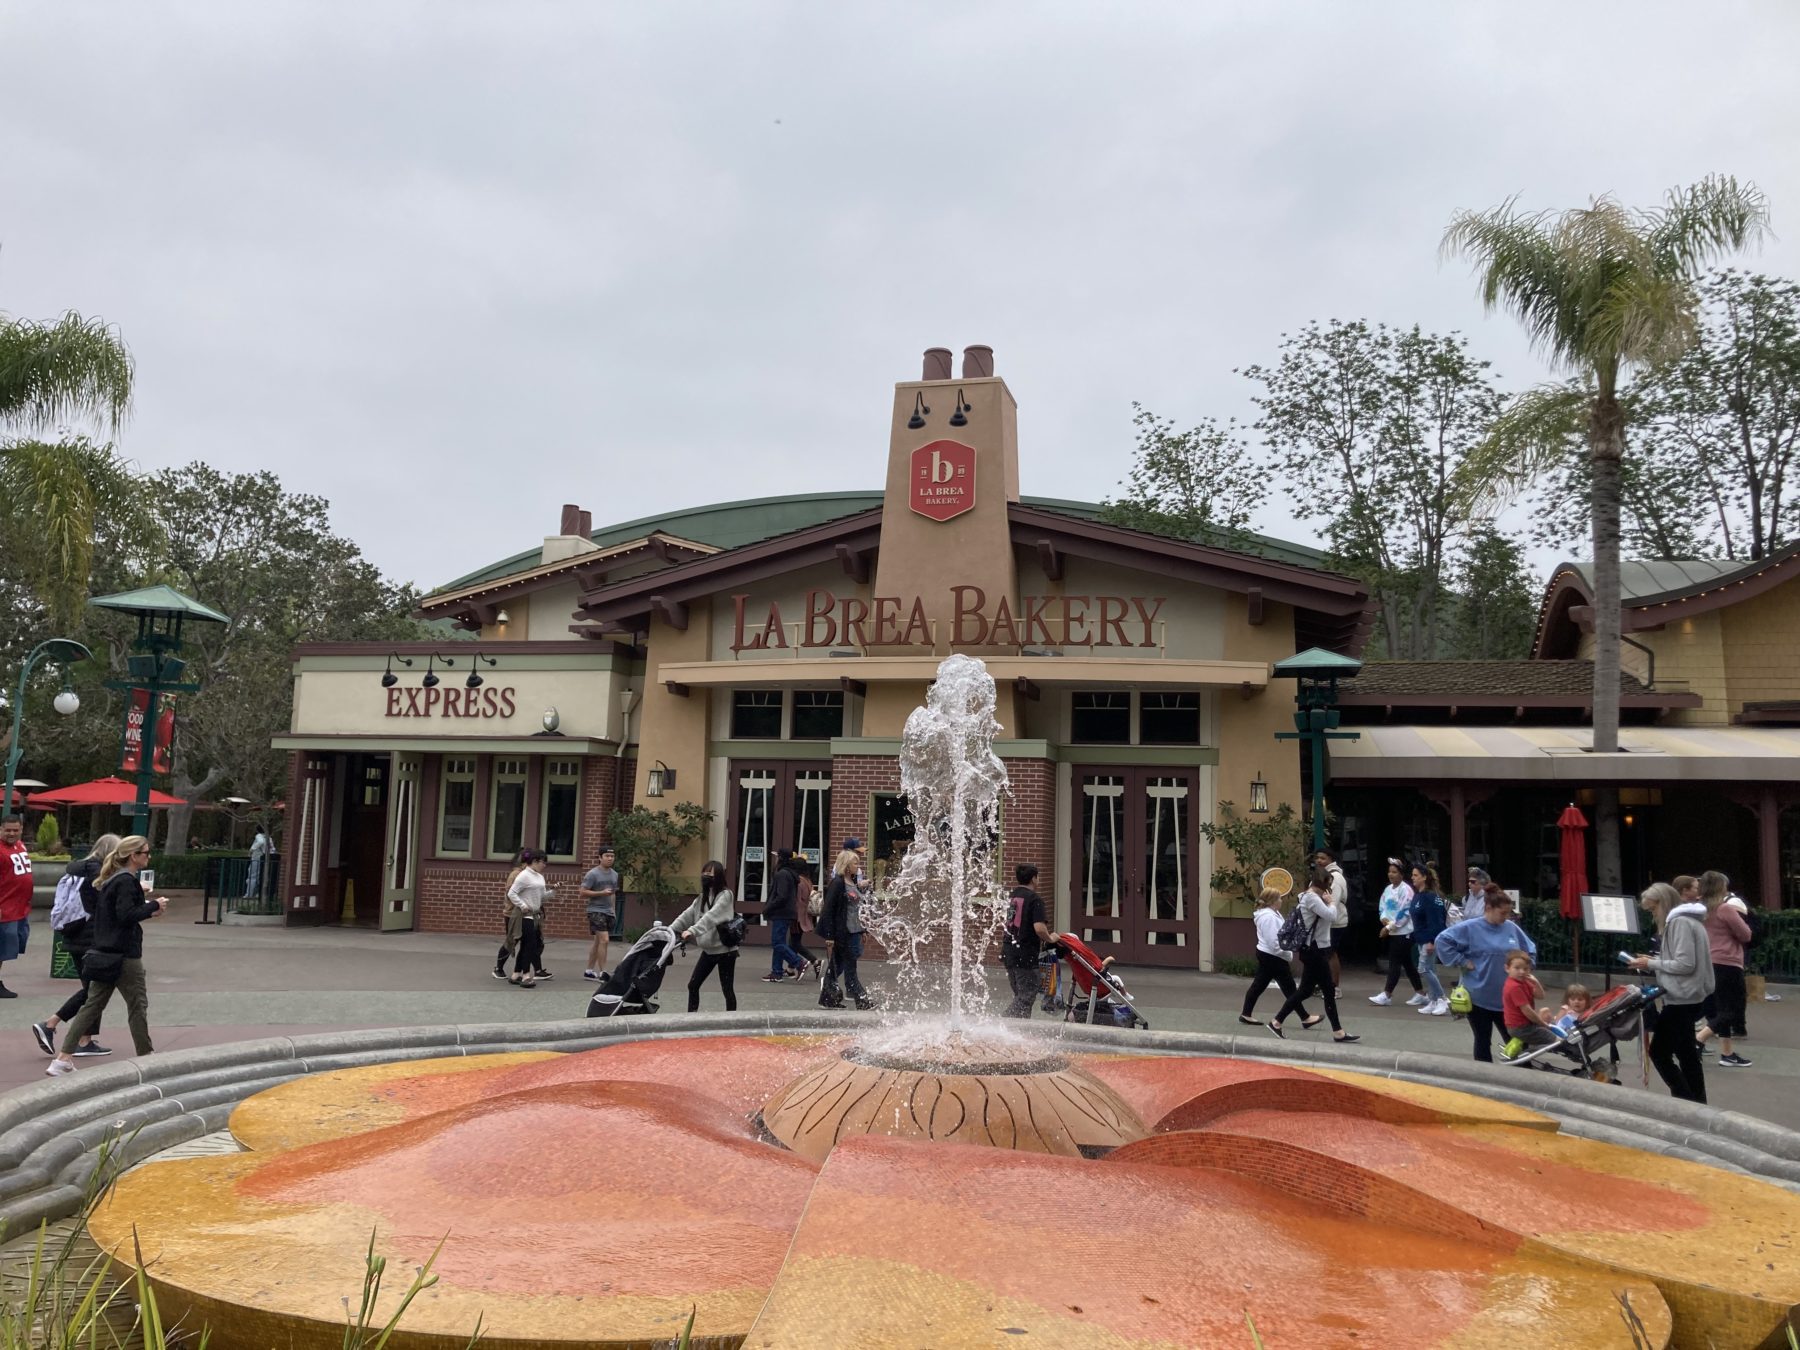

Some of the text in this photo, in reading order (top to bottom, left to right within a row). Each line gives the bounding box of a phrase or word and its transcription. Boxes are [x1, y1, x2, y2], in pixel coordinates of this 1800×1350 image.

[931, 450, 954, 483] b
[920, 487, 964, 496] LA BREA
[730, 585, 1167, 650] LA BREA BAKERY
[385, 687, 516, 718] EXPRESS
[884, 819, 901, 831] LA
[10, 851, 32, 875] 85
